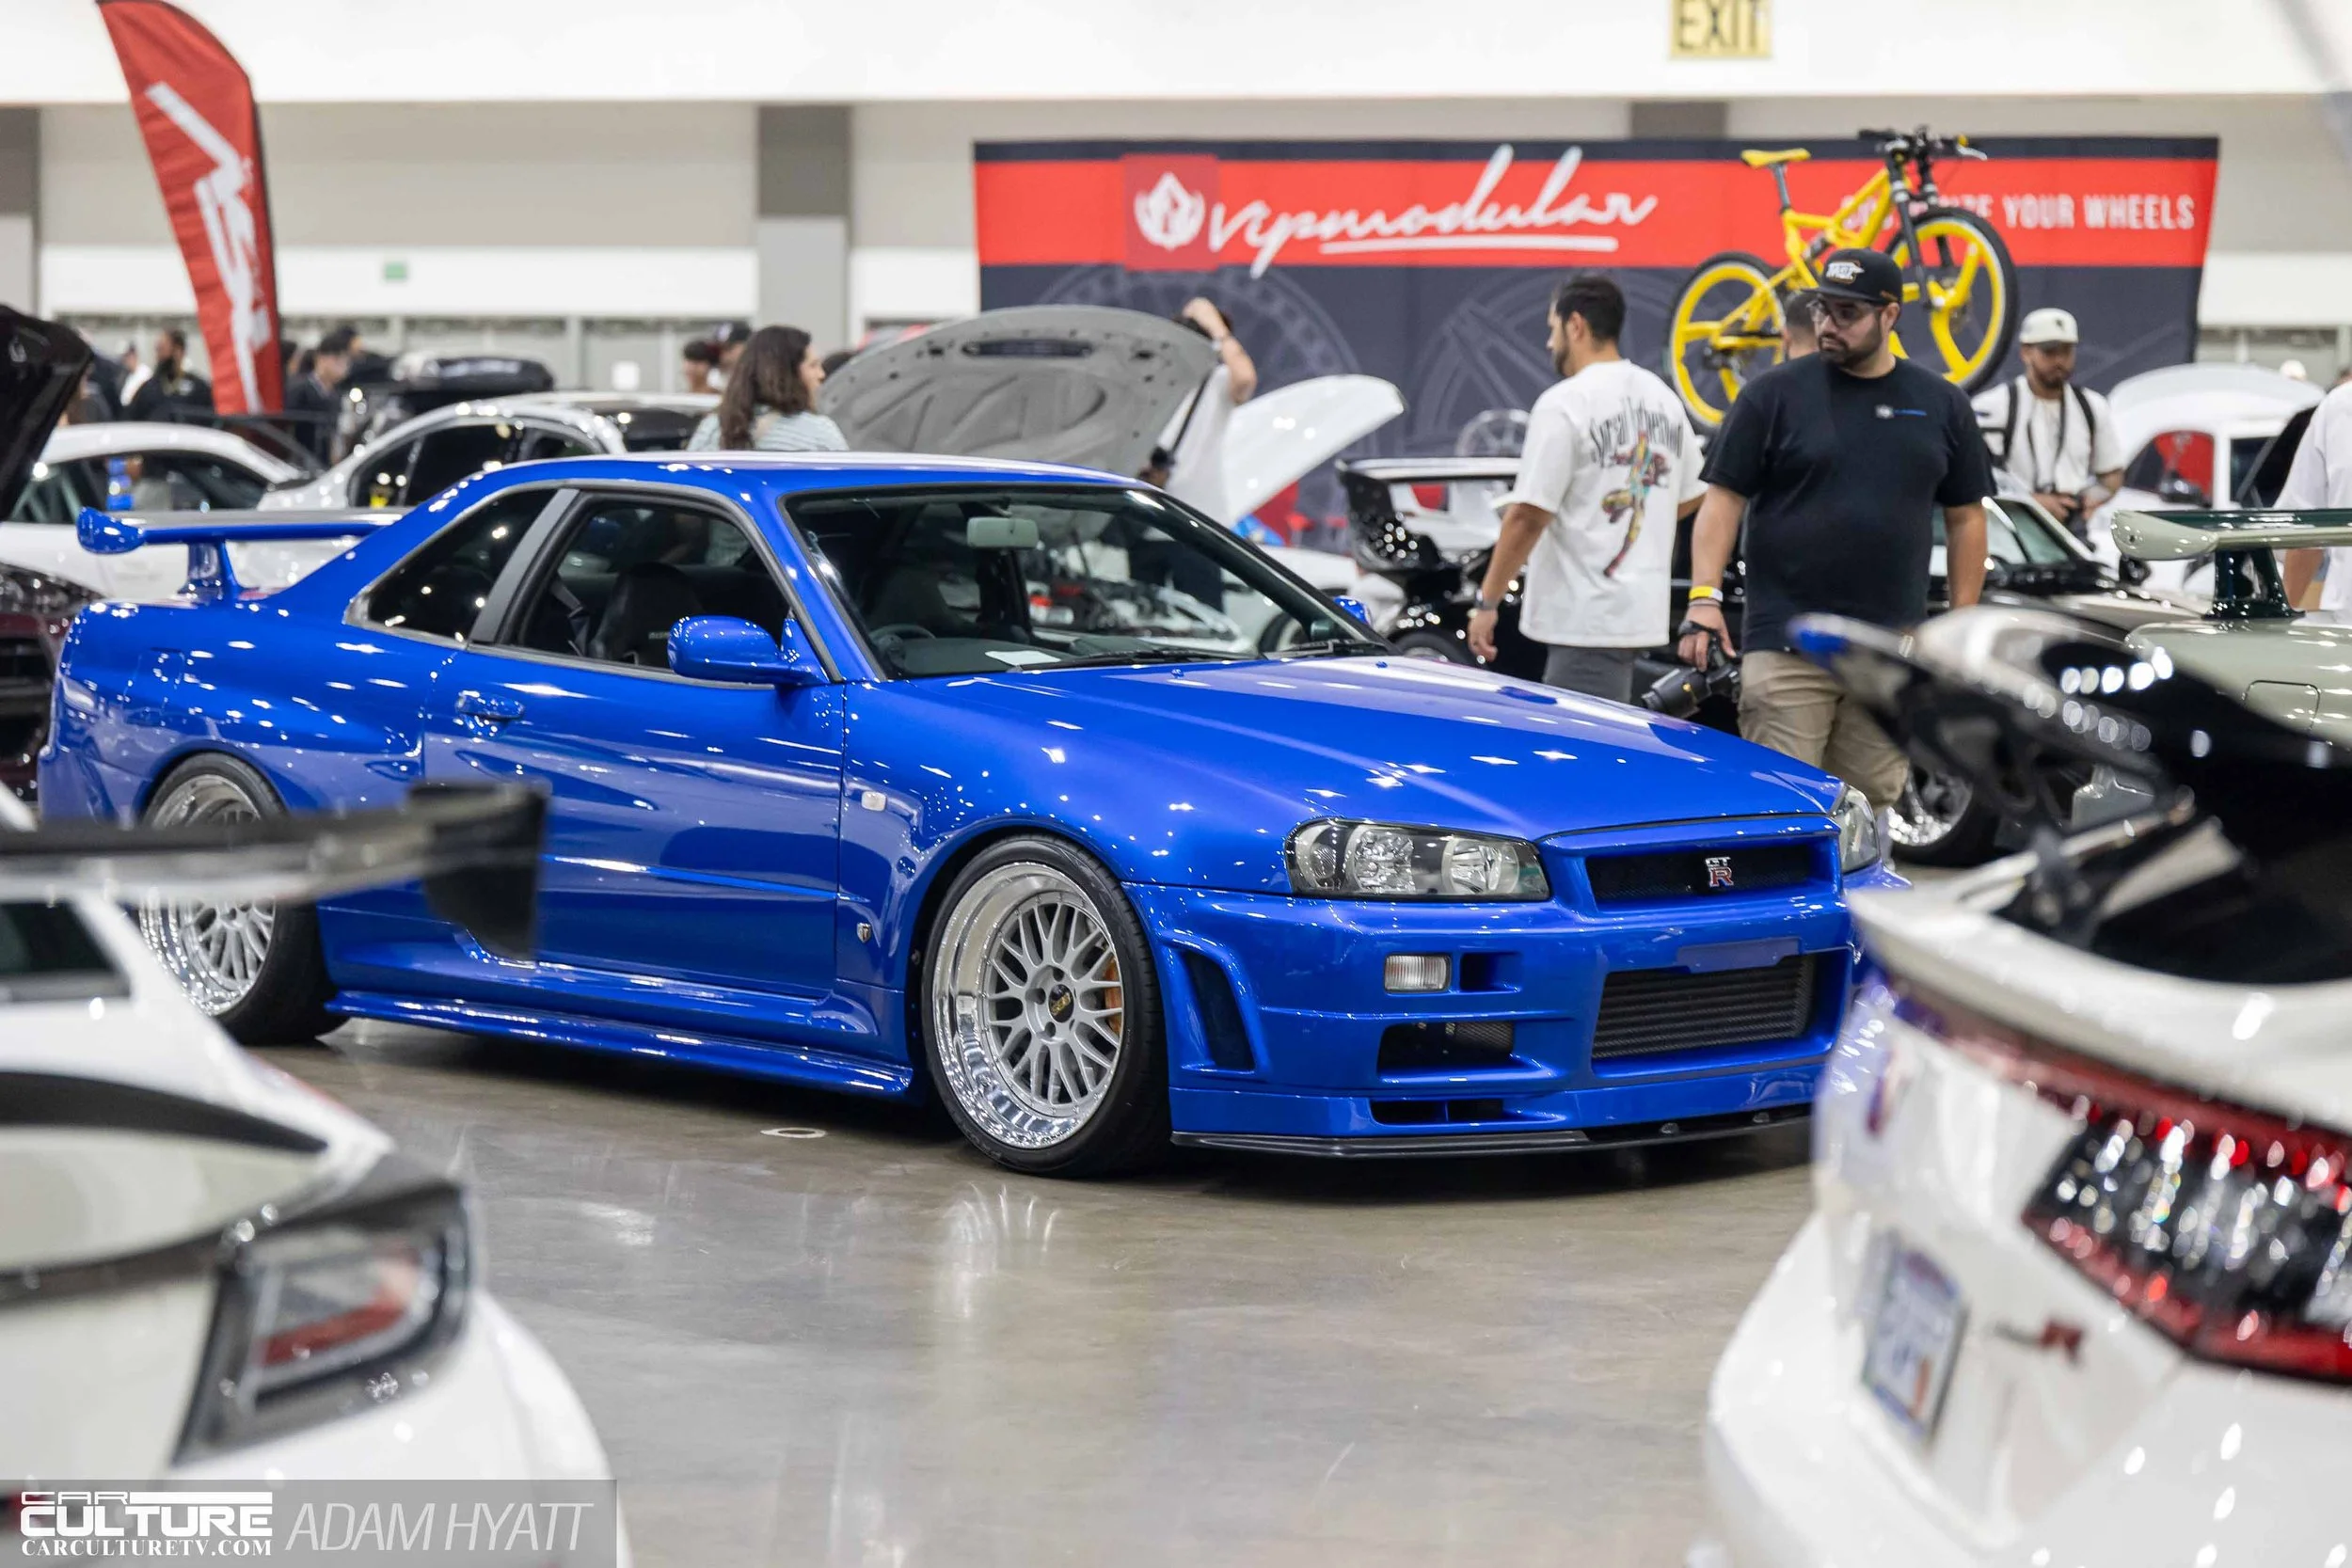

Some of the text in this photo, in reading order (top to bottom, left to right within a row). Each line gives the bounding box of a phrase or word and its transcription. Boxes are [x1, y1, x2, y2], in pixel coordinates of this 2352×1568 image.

[1677, 0, 1766, 49] EXIT
[2001, 193, 2074, 230] YOUR
[2082, 193, 2195, 230] WHEELS
